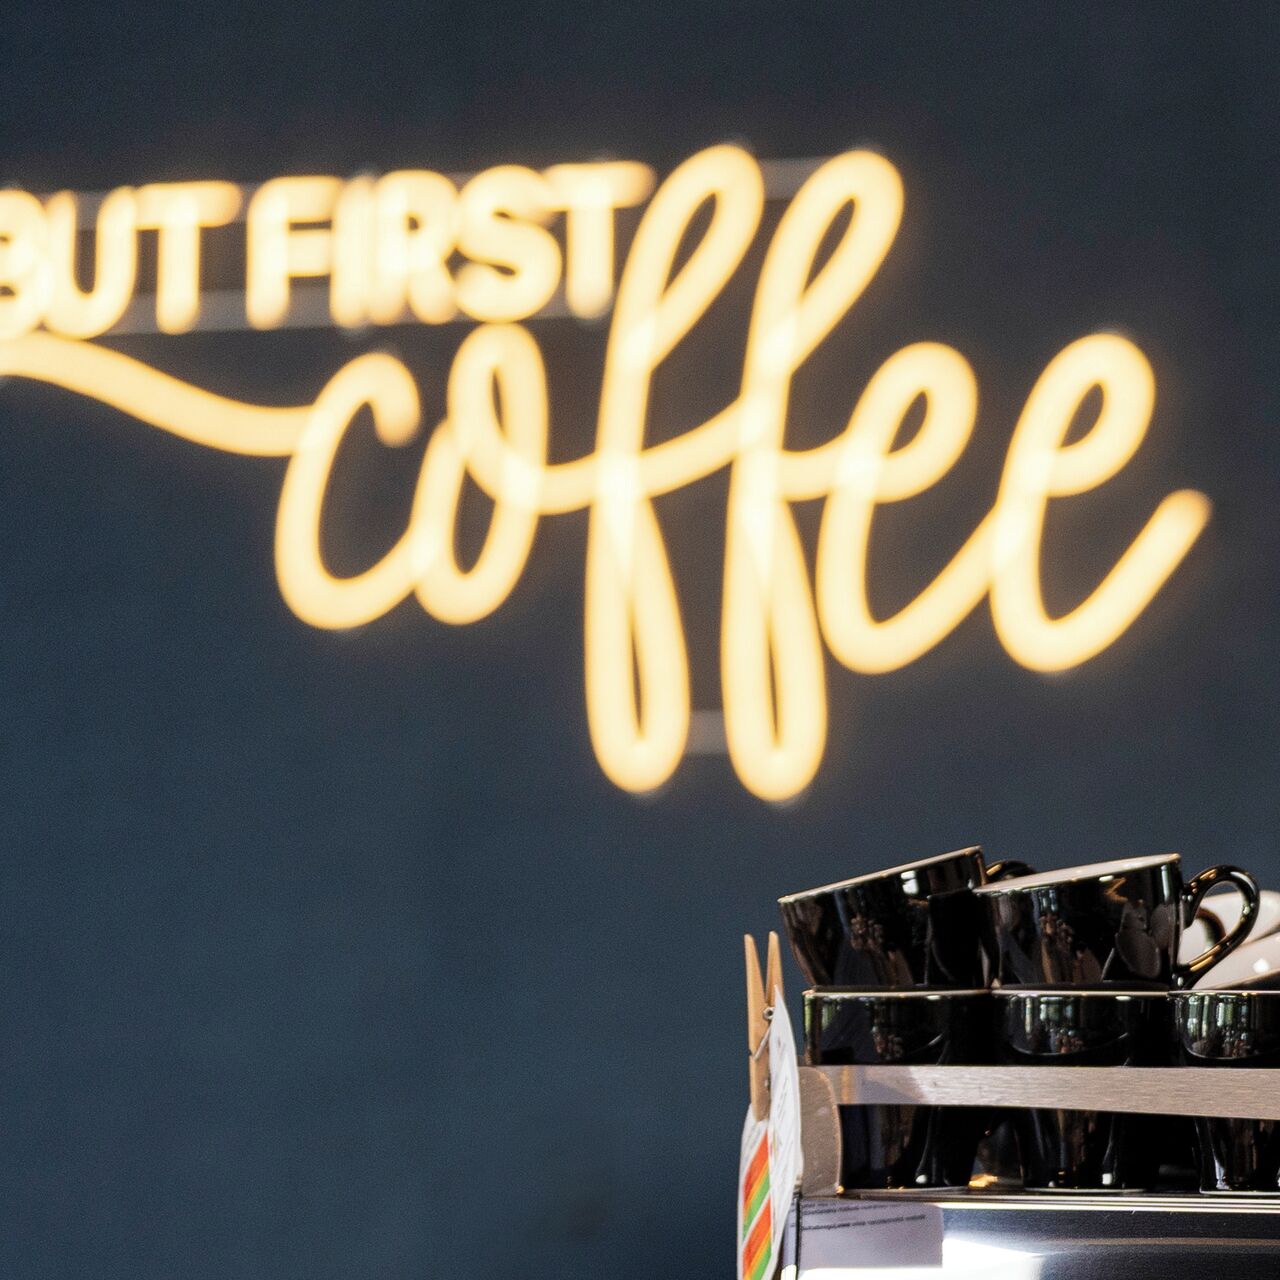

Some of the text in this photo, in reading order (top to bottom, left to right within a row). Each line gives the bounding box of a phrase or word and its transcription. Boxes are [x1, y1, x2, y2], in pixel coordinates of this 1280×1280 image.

[0, 160, 656, 342] BUT FIRST
[270, 142, 1214, 802] coffee
